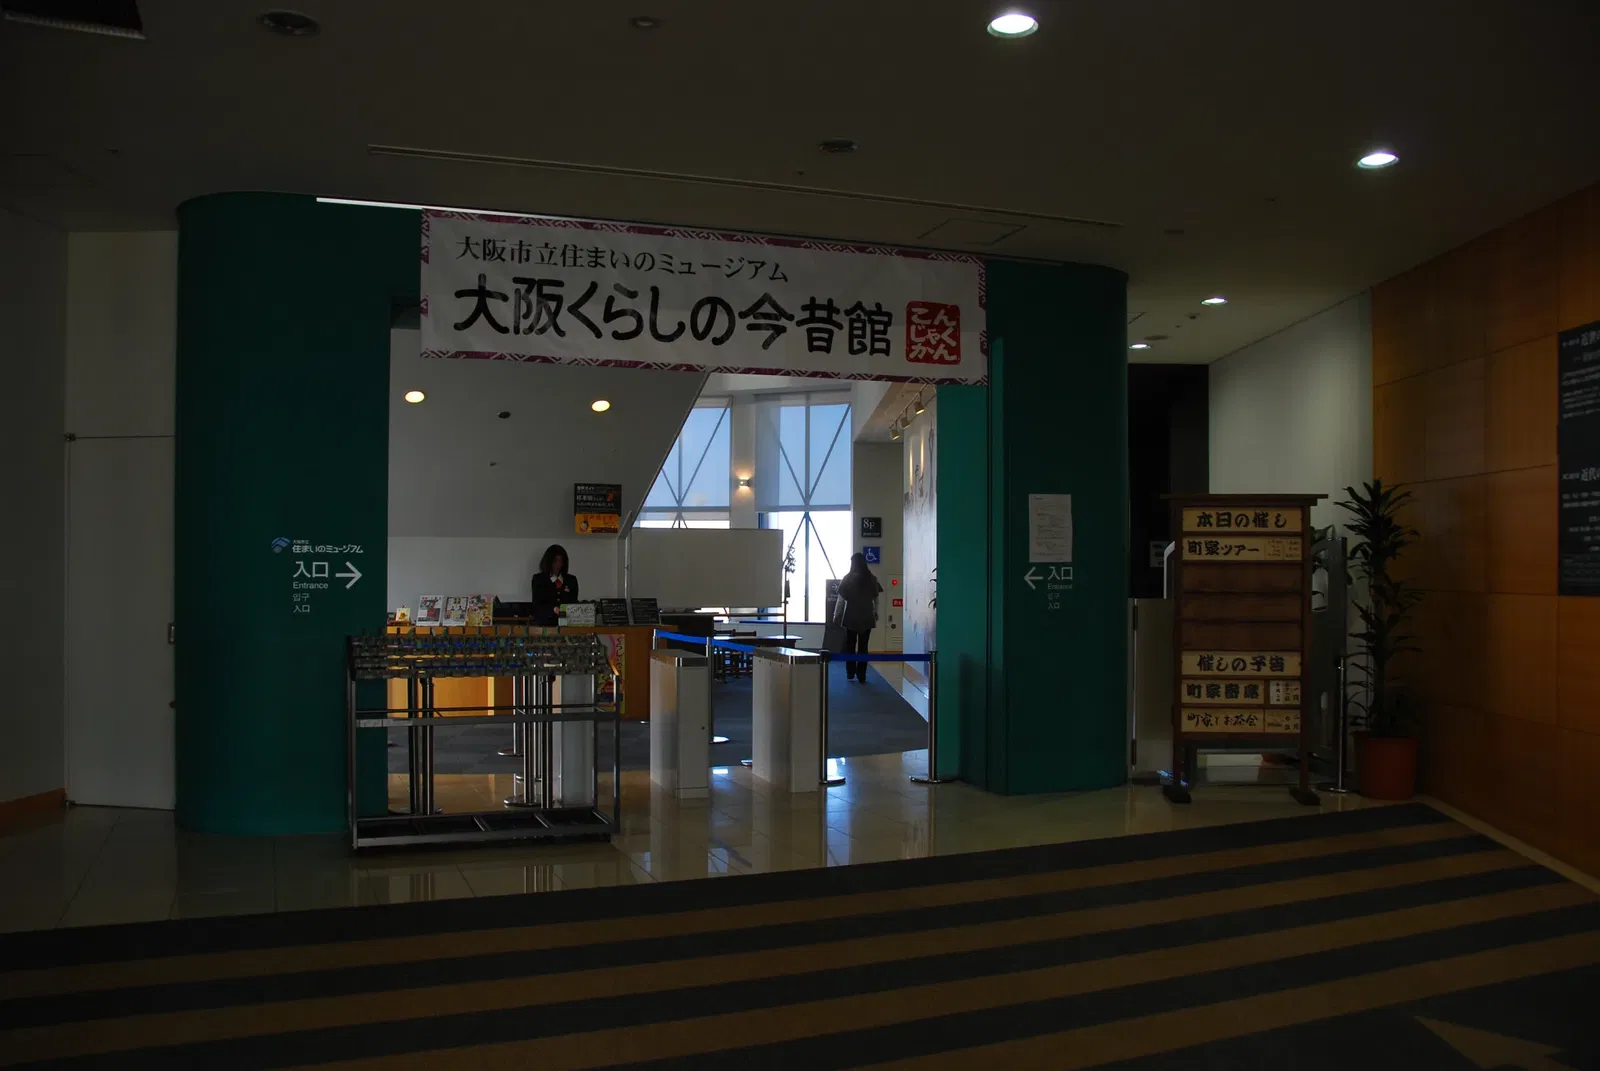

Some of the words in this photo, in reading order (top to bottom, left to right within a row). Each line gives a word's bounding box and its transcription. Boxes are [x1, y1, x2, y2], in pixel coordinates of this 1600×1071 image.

[456, 236, 789, 284] 大阪市立住まいのミュージアム
[453, 273, 893, 357] 大阪くらしの今昔館
[1196, 511, 1287, 529] 本日の催し
[292, 544, 364, 554] 住まいのミュージアム
[1187, 540, 1260, 556] 町家ツアー
[292, 560, 329, 578] 入口
[1047, 566, 1073, 581] 入口
[292, 581, 329, 590] Entrance
[292, 605, 311, 614] 入口
[1047, 602, 1061, 611] 入口
